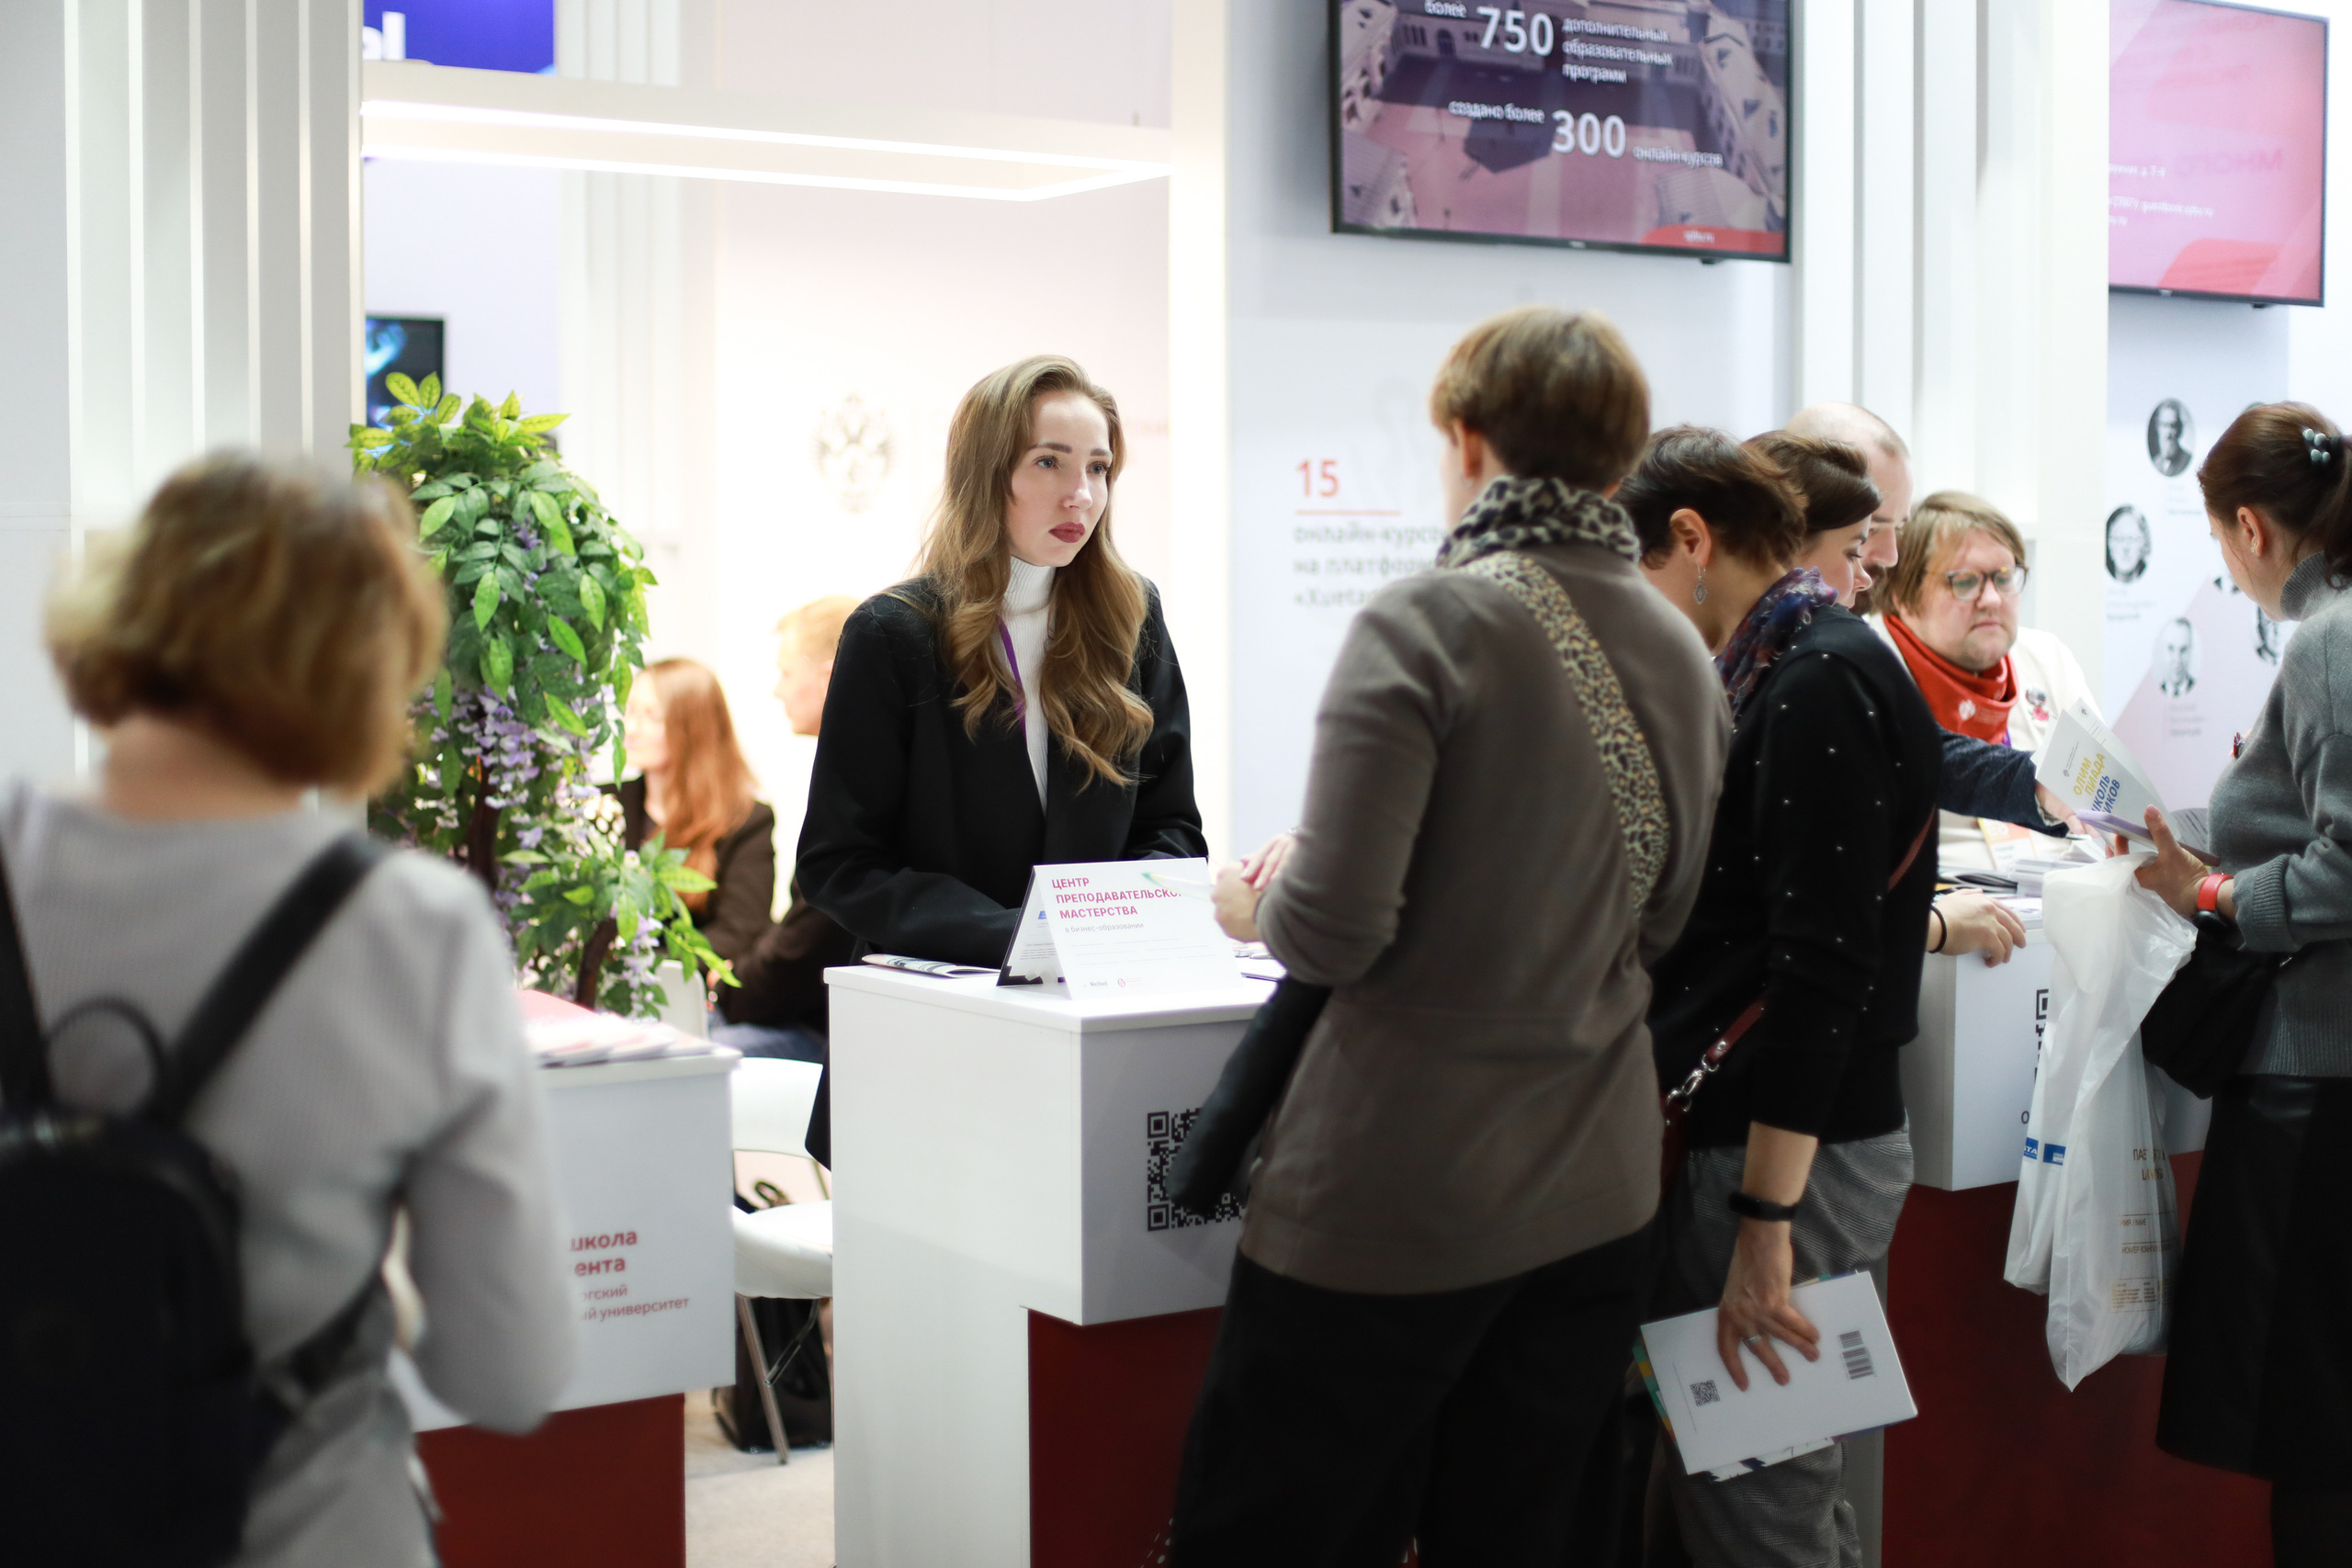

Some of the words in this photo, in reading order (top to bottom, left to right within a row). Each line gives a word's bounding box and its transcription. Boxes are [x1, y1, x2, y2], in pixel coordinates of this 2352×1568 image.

[1425, 0, 1467, 18] более
[1476, 6, 1554, 57] 750
[1562, 17, 1669, 43] дополнительных
[1562, 39, 1673, 66] образовательных
[1562, 63, 1627, 85] программ
[1448, 100, 1504, 120] создано
[1504, 102, 1545, 124] более
[1551, 111, 1626, 158] 300
[1295, 458, 1340, 497] 15
[1293, 522, 1444, 548] онлайн-курсо
[1293, 558, 1319, 574] на
[1326, 554, 1435, 578] платформ
[2074, 757, 2092, 795] ОЛИМ
[2085, 753, 2105, 795] ПИАДА
[2103, 779, 2120, 814] ИКОВ
[1052, 877, 1090, 890] ЦЕНТР
[1056, 888, 1182, 904] ПРЕПОДАВАТЕЛЬСКО
[1059, 906, 1138, 919] МАСТЕРСТВА
[1071, 922, 1145, 932] бизнес-образовании
[574, 1257, 626, 1277] ента
[581, 1283, 628, 1301] гский
[600, 1297, 690, 1322] университет
